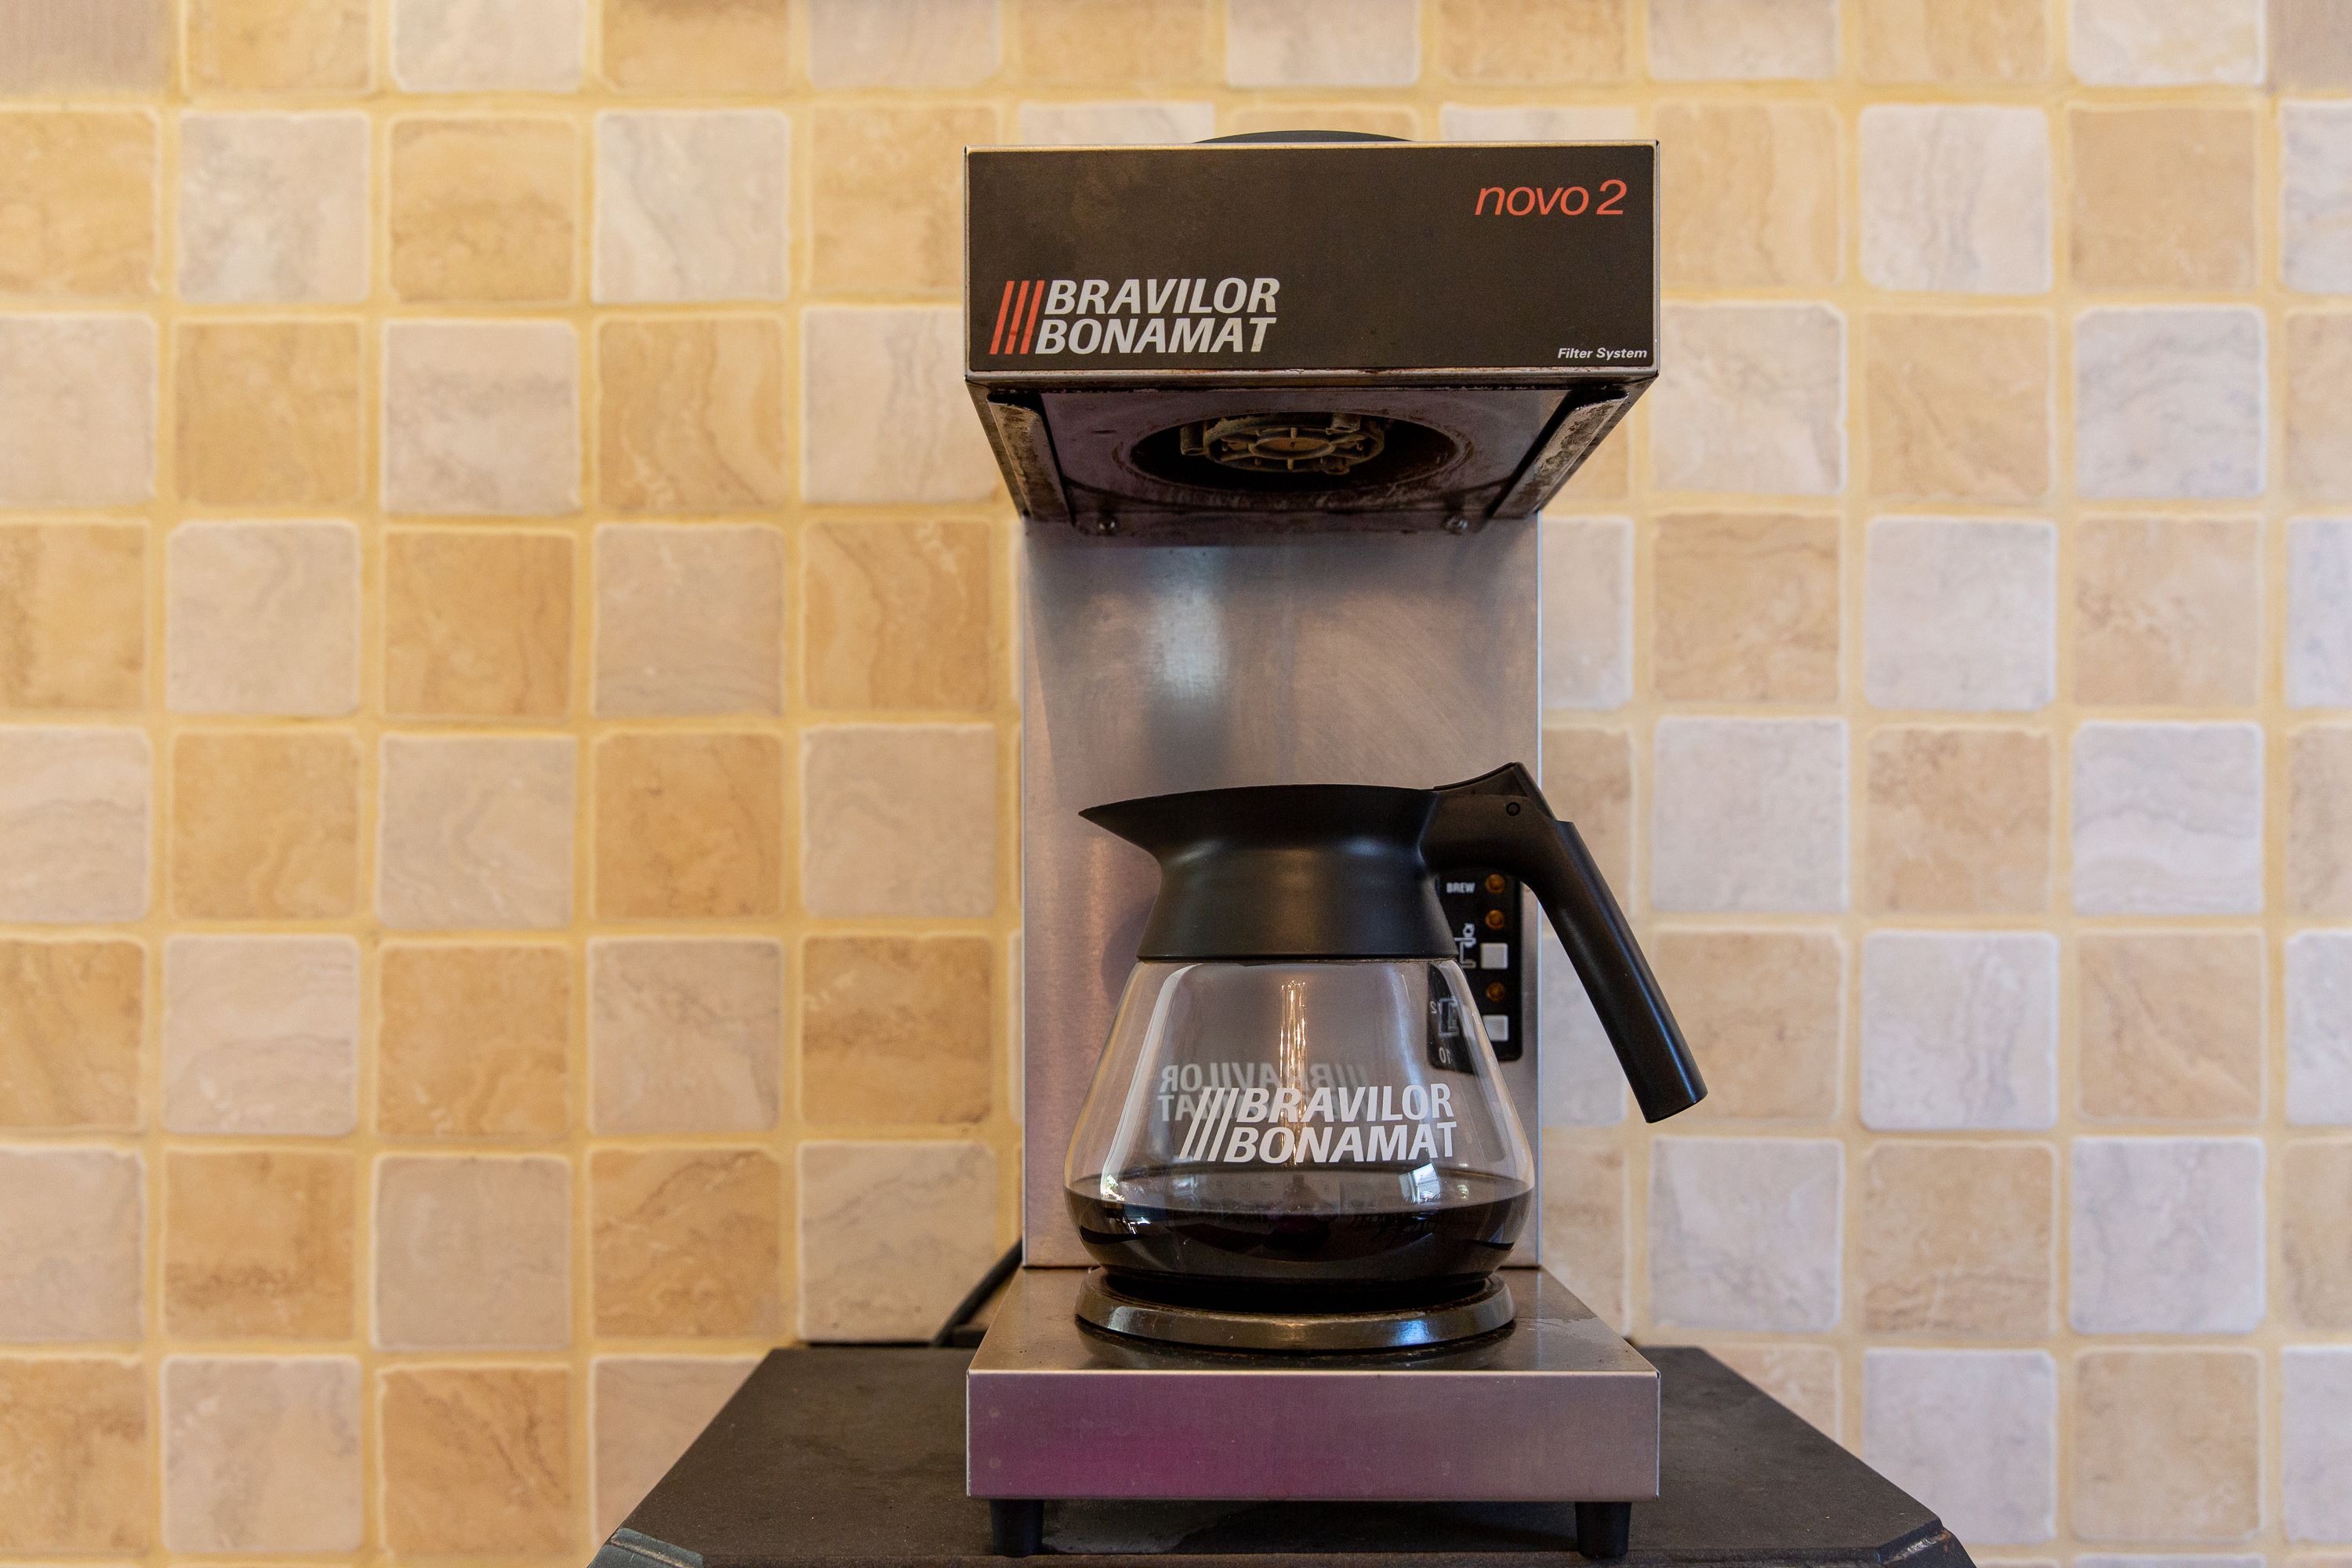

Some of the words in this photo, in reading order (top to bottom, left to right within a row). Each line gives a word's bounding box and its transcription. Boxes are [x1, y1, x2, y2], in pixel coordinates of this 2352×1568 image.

[1474, 186, 1589, 216] novo
[1595, 179, 1628, 216] 2
[1044, 278, 1280, 314] BRAVILOR
[1035, 318, 1277, 354] BONAMAT
[1557, 347, 1593, 359] Filter
[1595, 347, 1647, 361] System
[1446, 882, 1475, 893] BREW
[1236, 1083, 1454, 1123] BRAVILOR
[1223, 1122, 1457, 1163] BONAMAT
